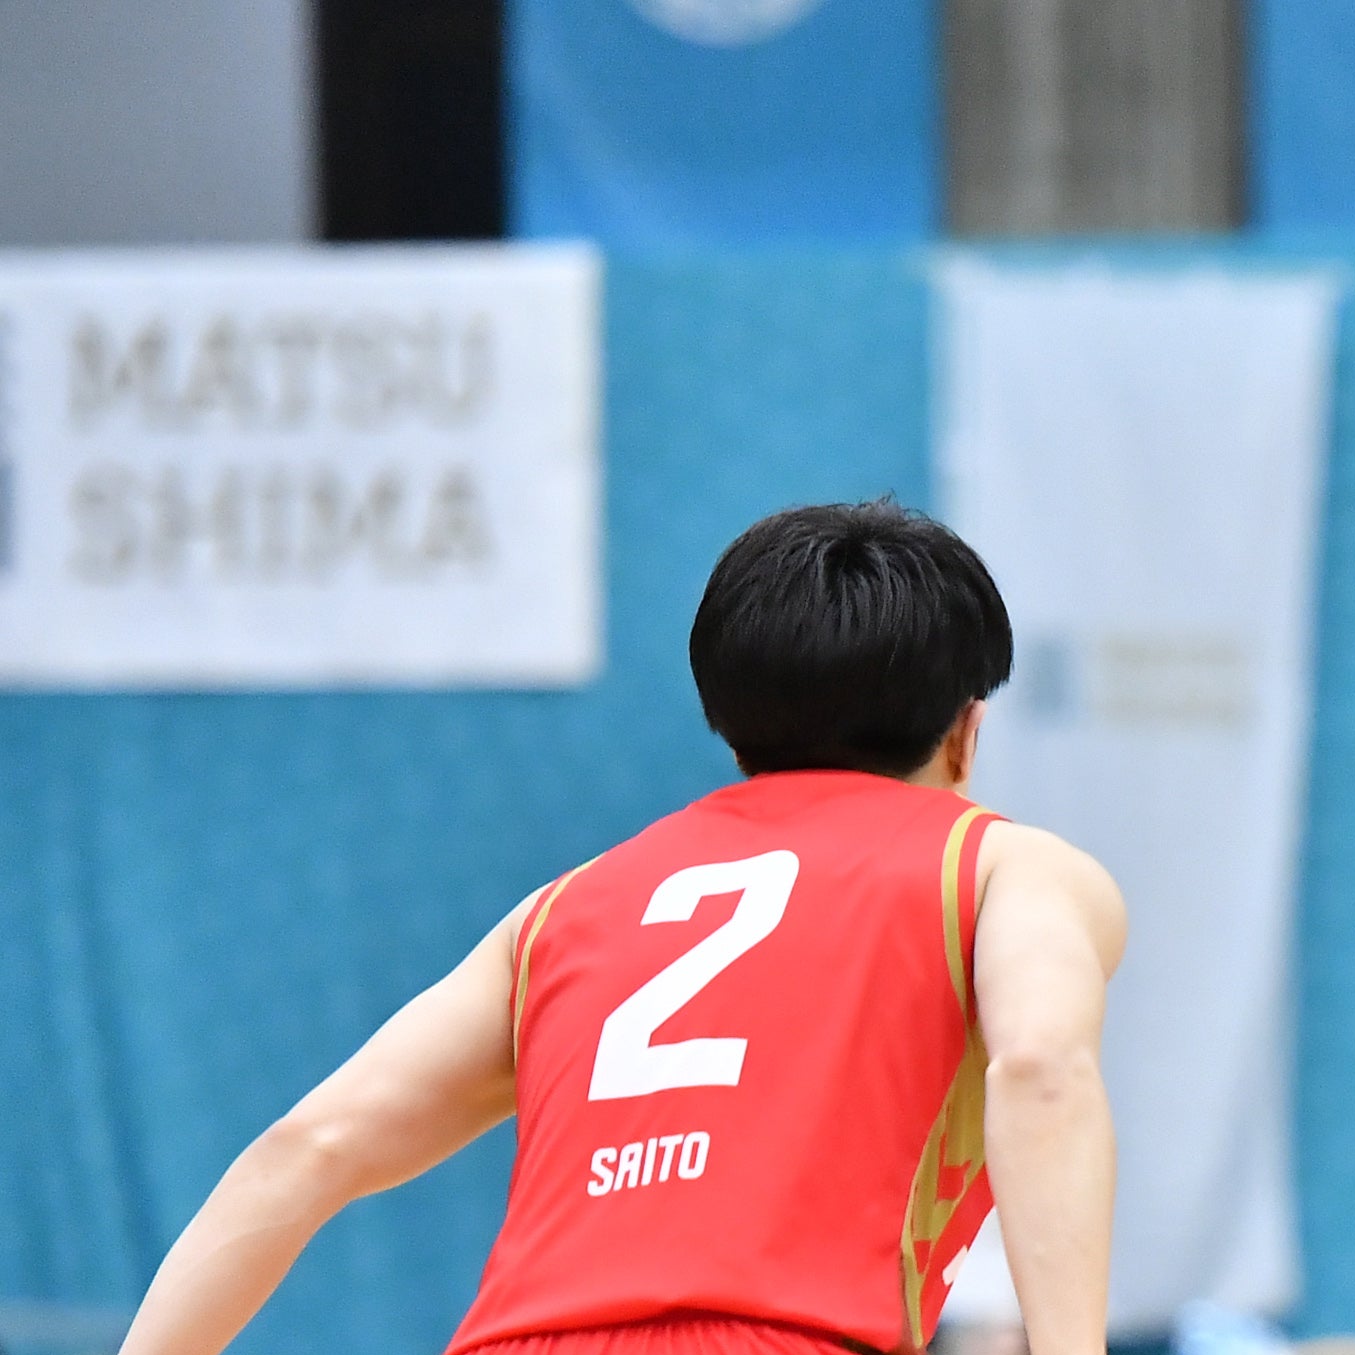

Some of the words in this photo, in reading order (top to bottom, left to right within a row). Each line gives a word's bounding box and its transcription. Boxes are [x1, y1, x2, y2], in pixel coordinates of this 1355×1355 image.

[70, 312, 494, 434] MATSU
[68, 463, 492, 582] SHIMA
[588, 850, 799, 1101] 2
[587, 1132, 710, 1197] SAITO
